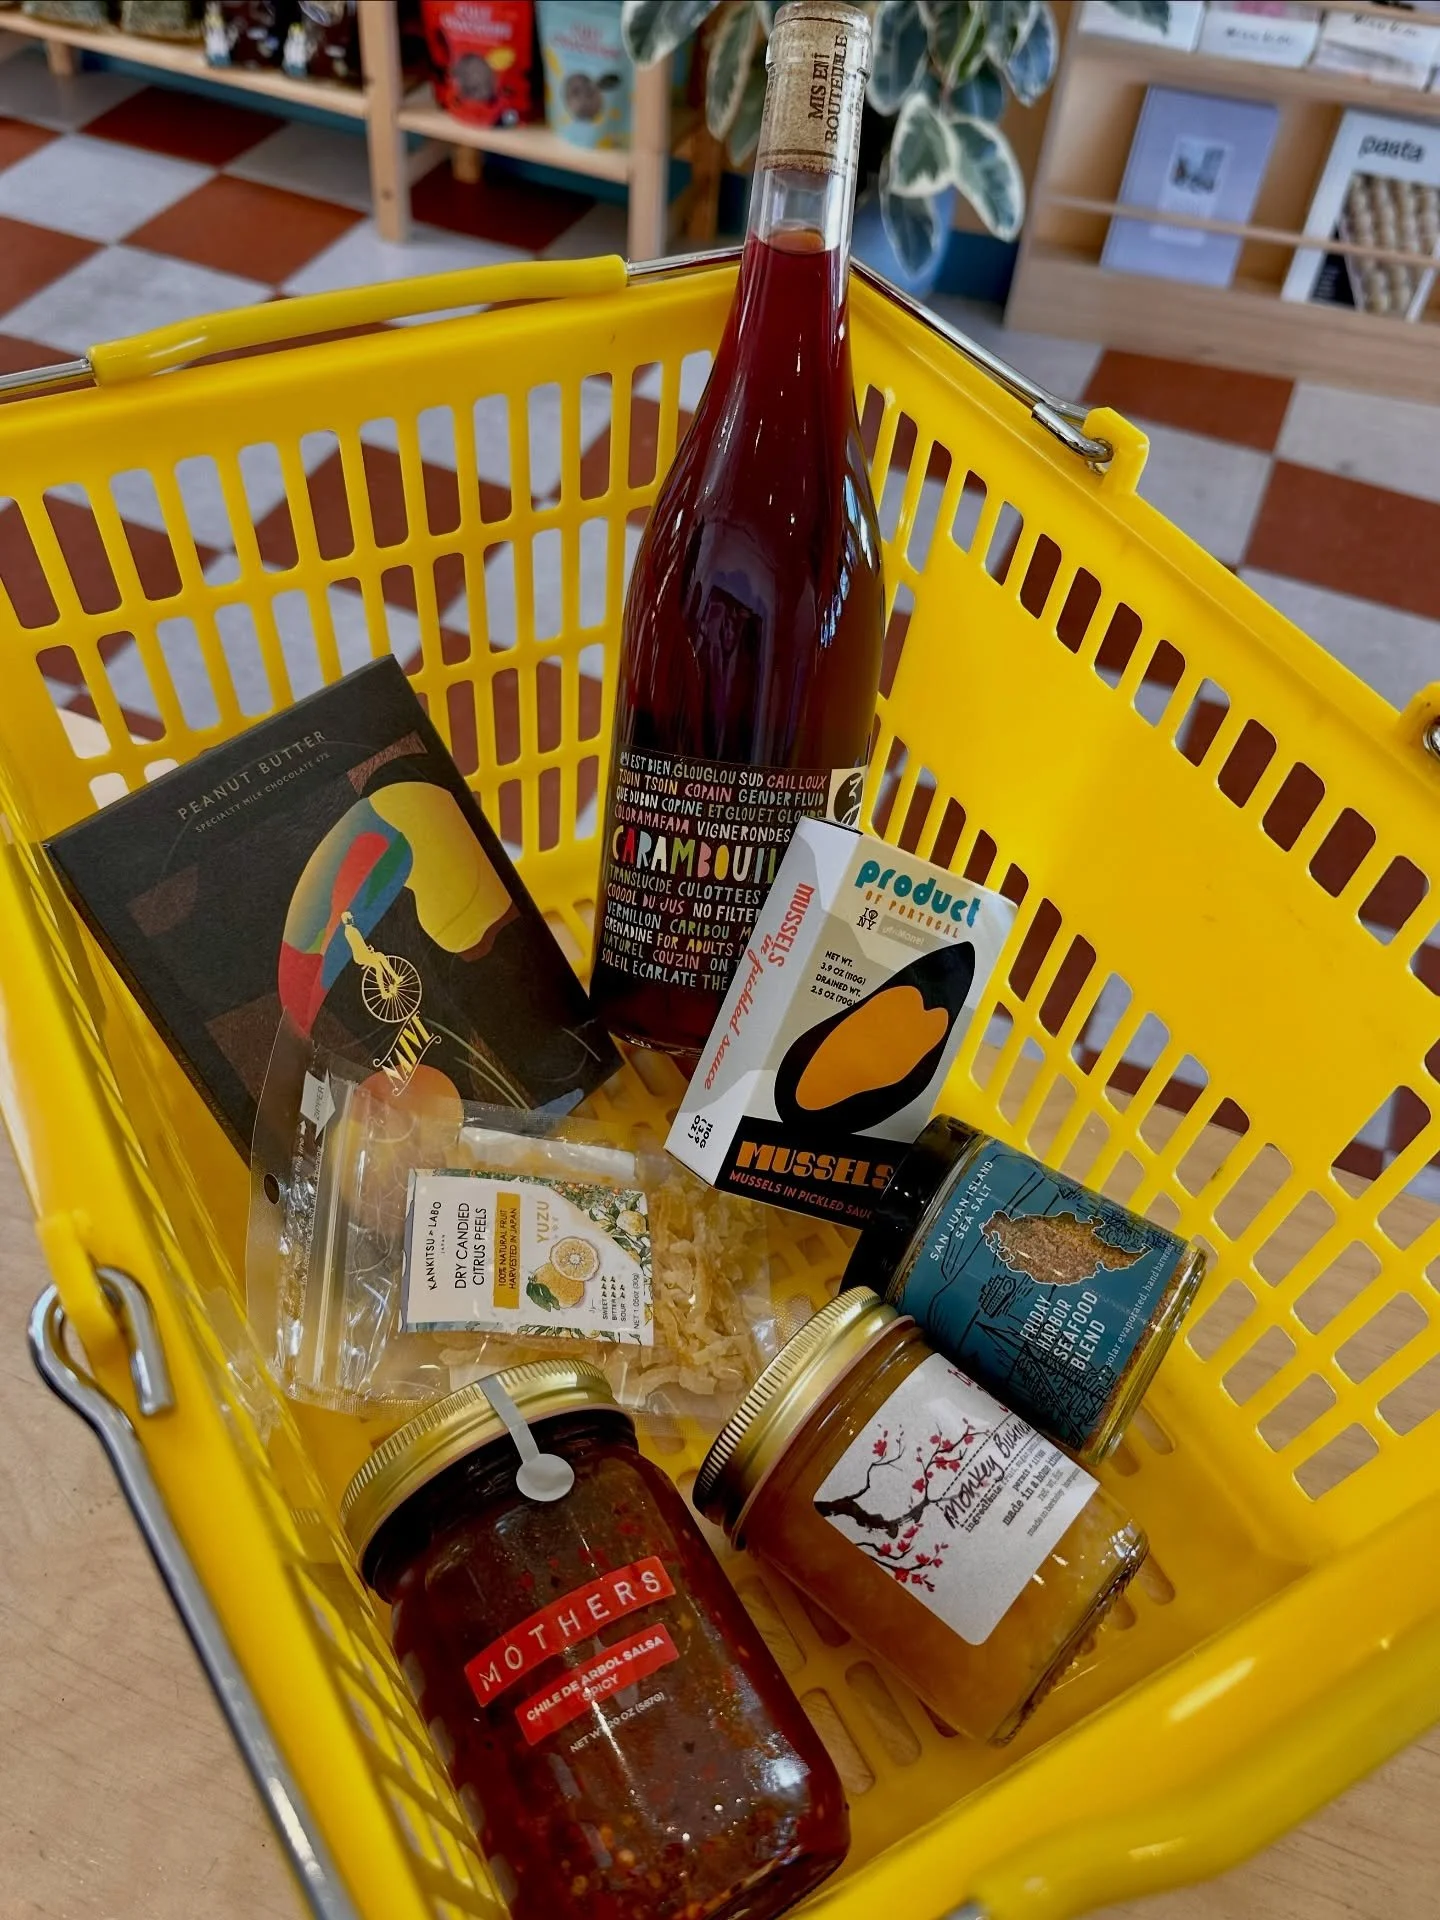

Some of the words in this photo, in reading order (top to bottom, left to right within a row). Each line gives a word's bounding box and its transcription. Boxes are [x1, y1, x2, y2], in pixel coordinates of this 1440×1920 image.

[808, 85, 827, 120] MIS
[1358, 134, 1425, 164] pasta
[177, 771, 252, 820] PEANUT
[258, 730, 326, 775] BUTTER
[619, 768, 641, 787] TSOIN
[645, 775, 679, 795] TSOIN
[684, 782, 733, 803] COPAIN
[738, 788, 793, 807] GENDER
[794, 791, 825, 807] FLUID
[631, 754, 647, 770] EST
[673, 763, 736, 785] GLOUGLOU
[738, 771, 764, 787] SUD
[195, 803, 241, 833] SPECIALTY
[243, 791, 263, 806] MILK
[265, 760, 315, 793] CHOCOLATE
[661, 797, 703, 817] COPINE
[609, 863, 672, 894] TRANSLUCIDE
[677, 881, 761, 905] CULOTTEES
[642, 892, 656, 909] DU
[659, 897, 685, 915] JUS
[693, 902, 712, 918] NO
[855, 860, 981, 928] product
[607, 900, 662, 930] VERMILLON
[669, 919, 730, 939] CARIBOU
[768, 882, 816, 968] MUSSELS
[856, 915, 876, 931] NY
[865, 890, 882, 904] OF
[888, 900, 961, 939] PORTUGAL
[603, 931, 644, 958] NATUREL
[652, 949, 700, 970] COUZIN
[710, 958, 729, 972] ON
[604, 915, 653, 944] GRENADINE
[657, 933, 679, 949] FOR
[686, 938, 734, 957] ADULTS
[760, 932, 774, 956] in
[601, 947, 629, 972] SOLEIL
[633, 960, 697, 988] ECARLATE
[820, 962, 833, 972] 3.9
[833, 967, 844, 977] OZ
[844, 971, 866, 986] (110G)
[825, 950, 841, 962] NET
[841, 956, 853, 968] WT.
[729, 948, 764, 1037] pickled
[810, 985, 823, 996] 2.5
[824, 990, 836, 1001] OZ
[815, 973, 848, 992] DRAINED
[849, 986, 861, 997] WT.
[704, 1033, 732, 1092] sauce
[313, 1085, 325, 1121] ZIPPER
[735, 1140, 894, 1190] MUSSELS
[729, 1169, 782, 1194] MUSSELS
[783, 1185, 796, 1198] IN
[797, 1189, 845, 1211] PICKLED
[930, 1233, 950, 1261] SAN
[946, 1197, 970, 1232] JUAN
[965, 1161, 994, 1197] ISLAND
[428, 1201, 442, 1228] LABO
[456, 1202, 470, 1260] CANDIED
[474, 1208, 487, 1240] PEELS
[500, 1209, 508, 1228] FRUIT
[510, 1208, 518, 1233] JAPAN
[536, 1201, 549, 1243] YUZU
[955, 1214, 975, 1240] SEA
[970, 1184, 992, 1212] SALT
[499, 1229, 508, 1265] NATURAL
[510, 1235, 517, 1243] IN
[425, 1238, 438, 1291] KANKITSU
[455, 1263, 467, 1289] DRY
[472, 1243, 486, 1286] CITRUS
[508, 1244, 518, 1289] HARVESTED
[1020, 1294, 1052, 1342] FRIDAY
[1035, 1298, 1073, 1352] HARBOR
[1053, 1291, 1099, 1361] SEAFOOD
[1105, 1343, 1121, 1368] solar
[1117, 1291, 1150, 1343] evaporated,
[1143, 1270, 1160, 1296] hand
[1070, 1319, 1106, 1371] BLEND
[943, 1454, 1005, 1529] Monkey
[1012, 1468, 1030, 1492] permit
[1002, 1499, 1025, 1526] made
[1021, 1488, 1034, 1501] in
[1033, 1481, 1039, 1489] a
[478, 1570, 662, 1691] MOTHERS
[526, 1693, 562, 1722] CHILE
[562, 1682, 581, 1699] DE
[581, 1660, 623, 1688] ARBOL
[623, 1635, 664, 1662] SALSA
[582, 1674, 620, 1703] SPICY
[569, 1734, 590, 1753] NET
[588, 1724, 606, 1740] W
[620, 1706, 636, 1720] OZ
